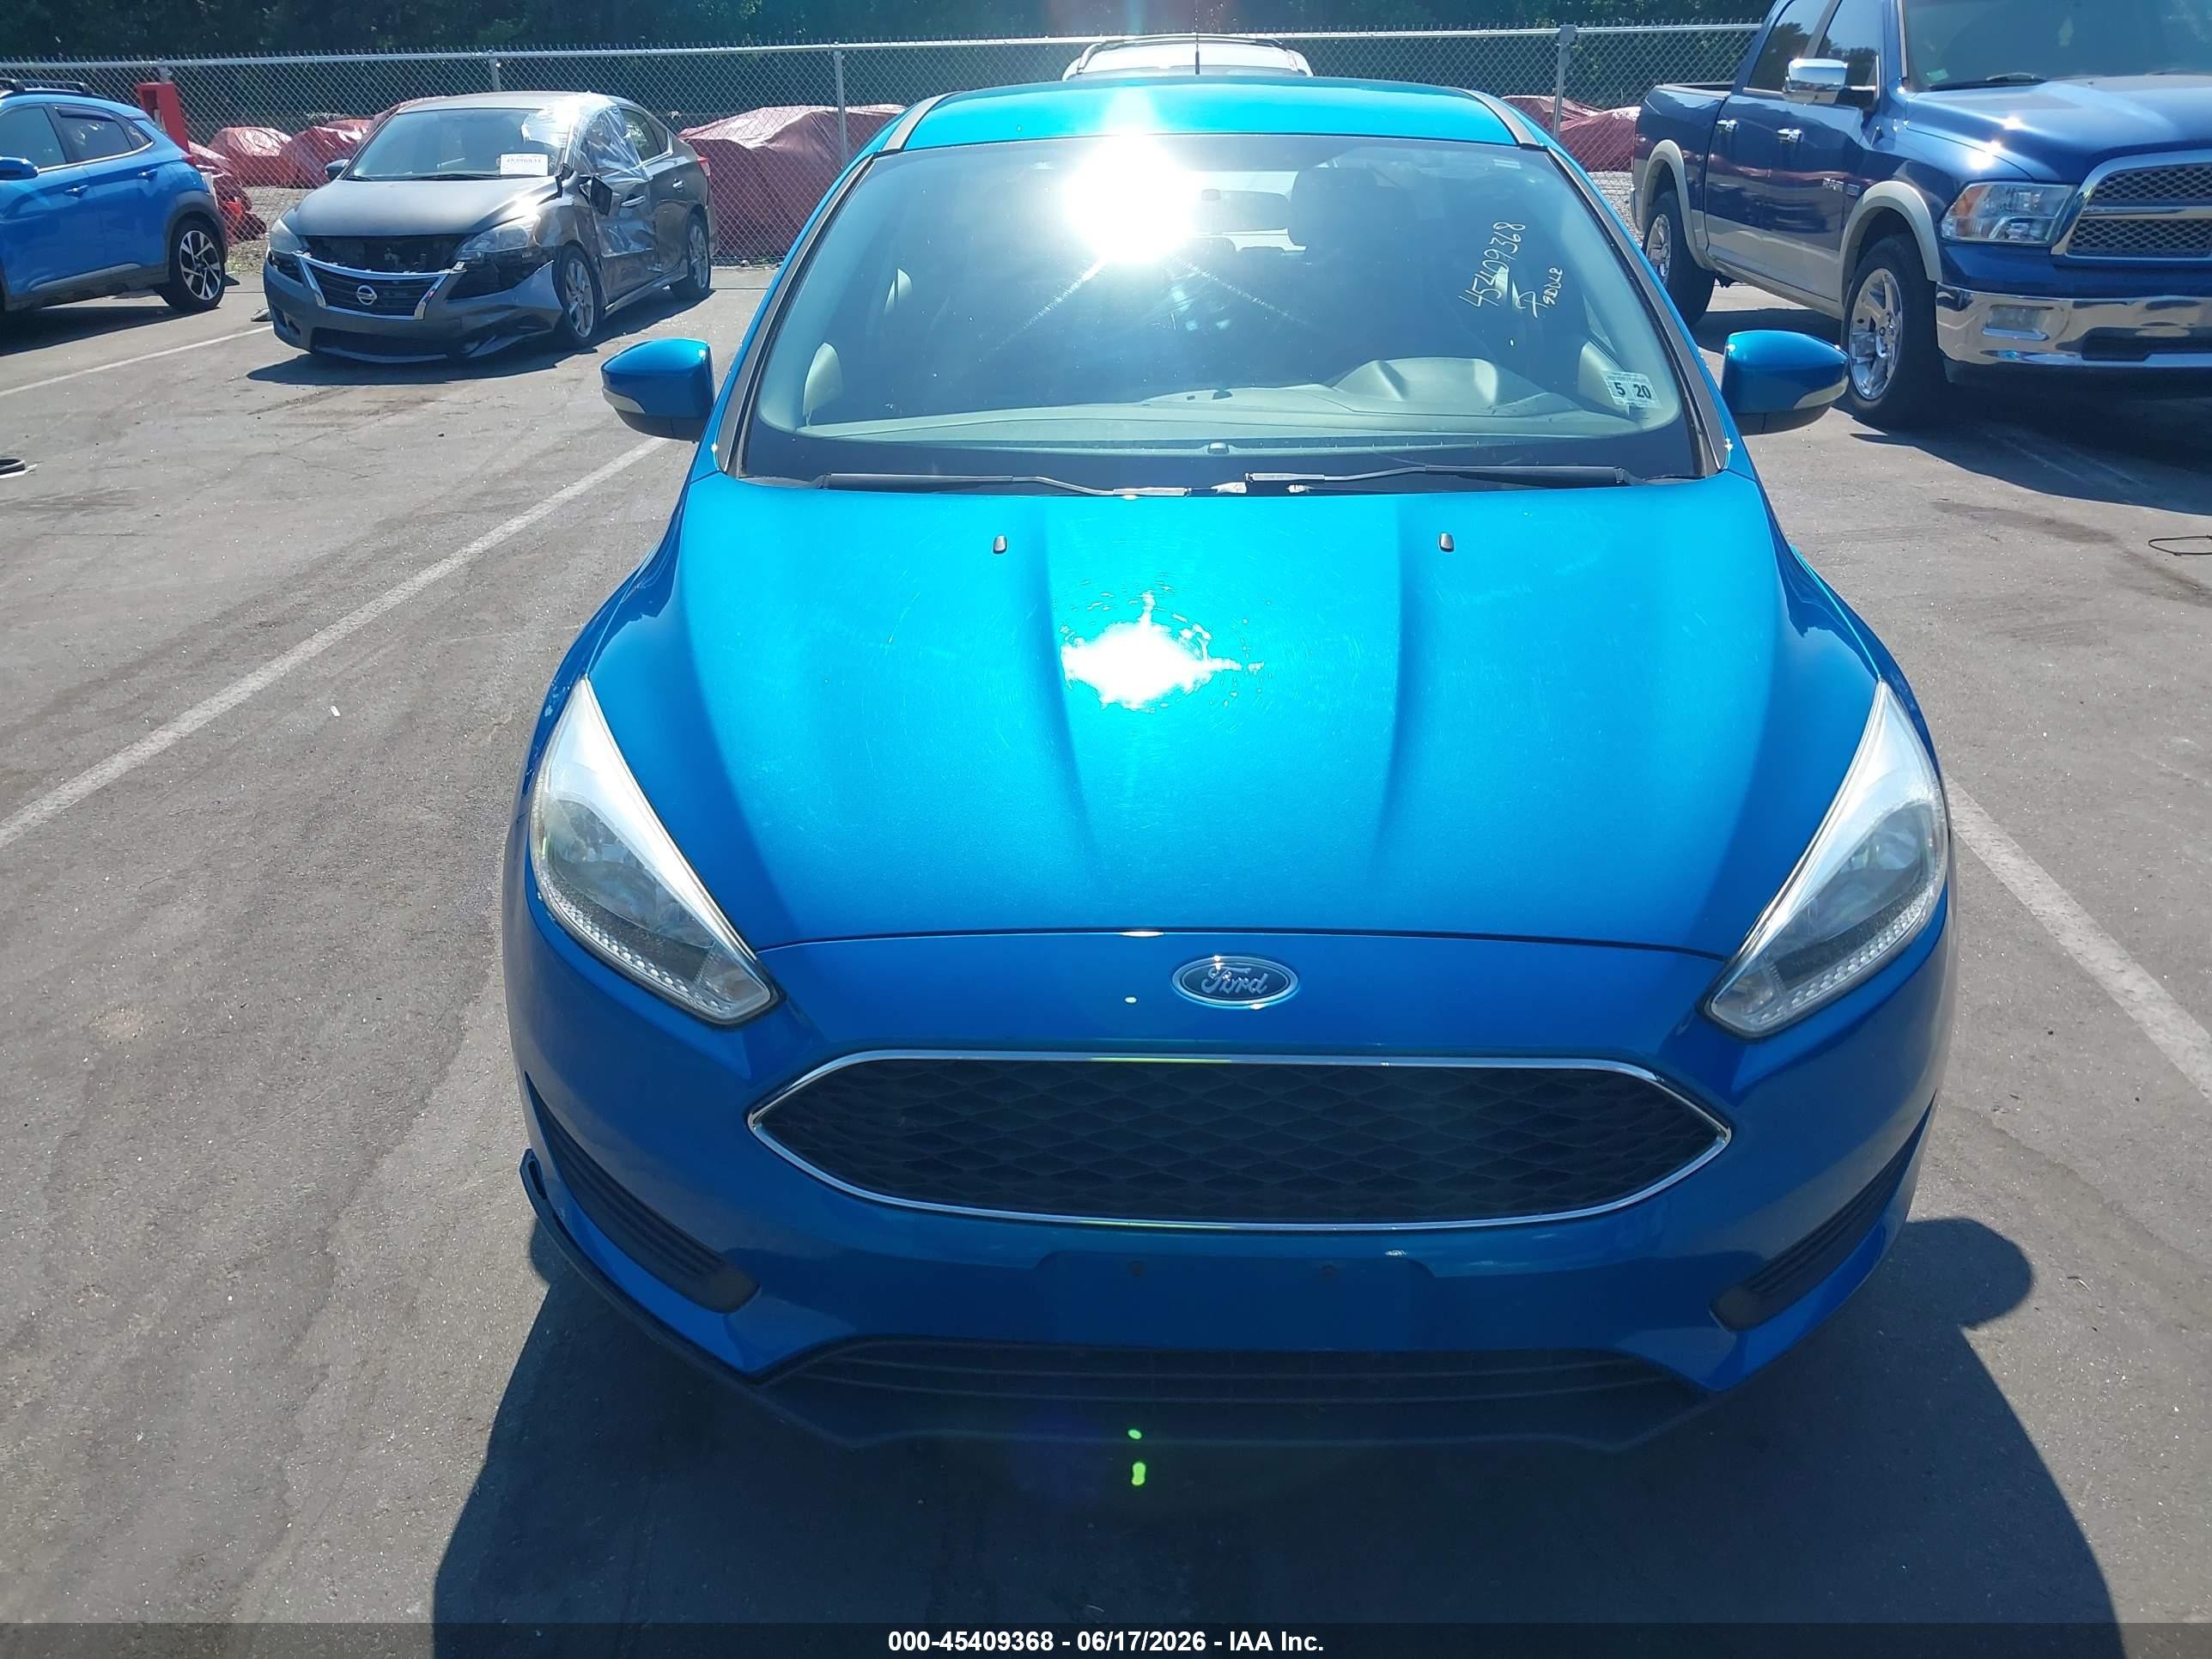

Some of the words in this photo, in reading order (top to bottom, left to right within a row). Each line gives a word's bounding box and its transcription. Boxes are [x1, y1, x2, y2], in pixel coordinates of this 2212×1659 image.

[1458, 222, 1526, 307] 45409368
[1613, 381, 1626, 396] 5
[1633, 383, 1652, 399] 20
[1200, 965, 1269, 994] Ford
